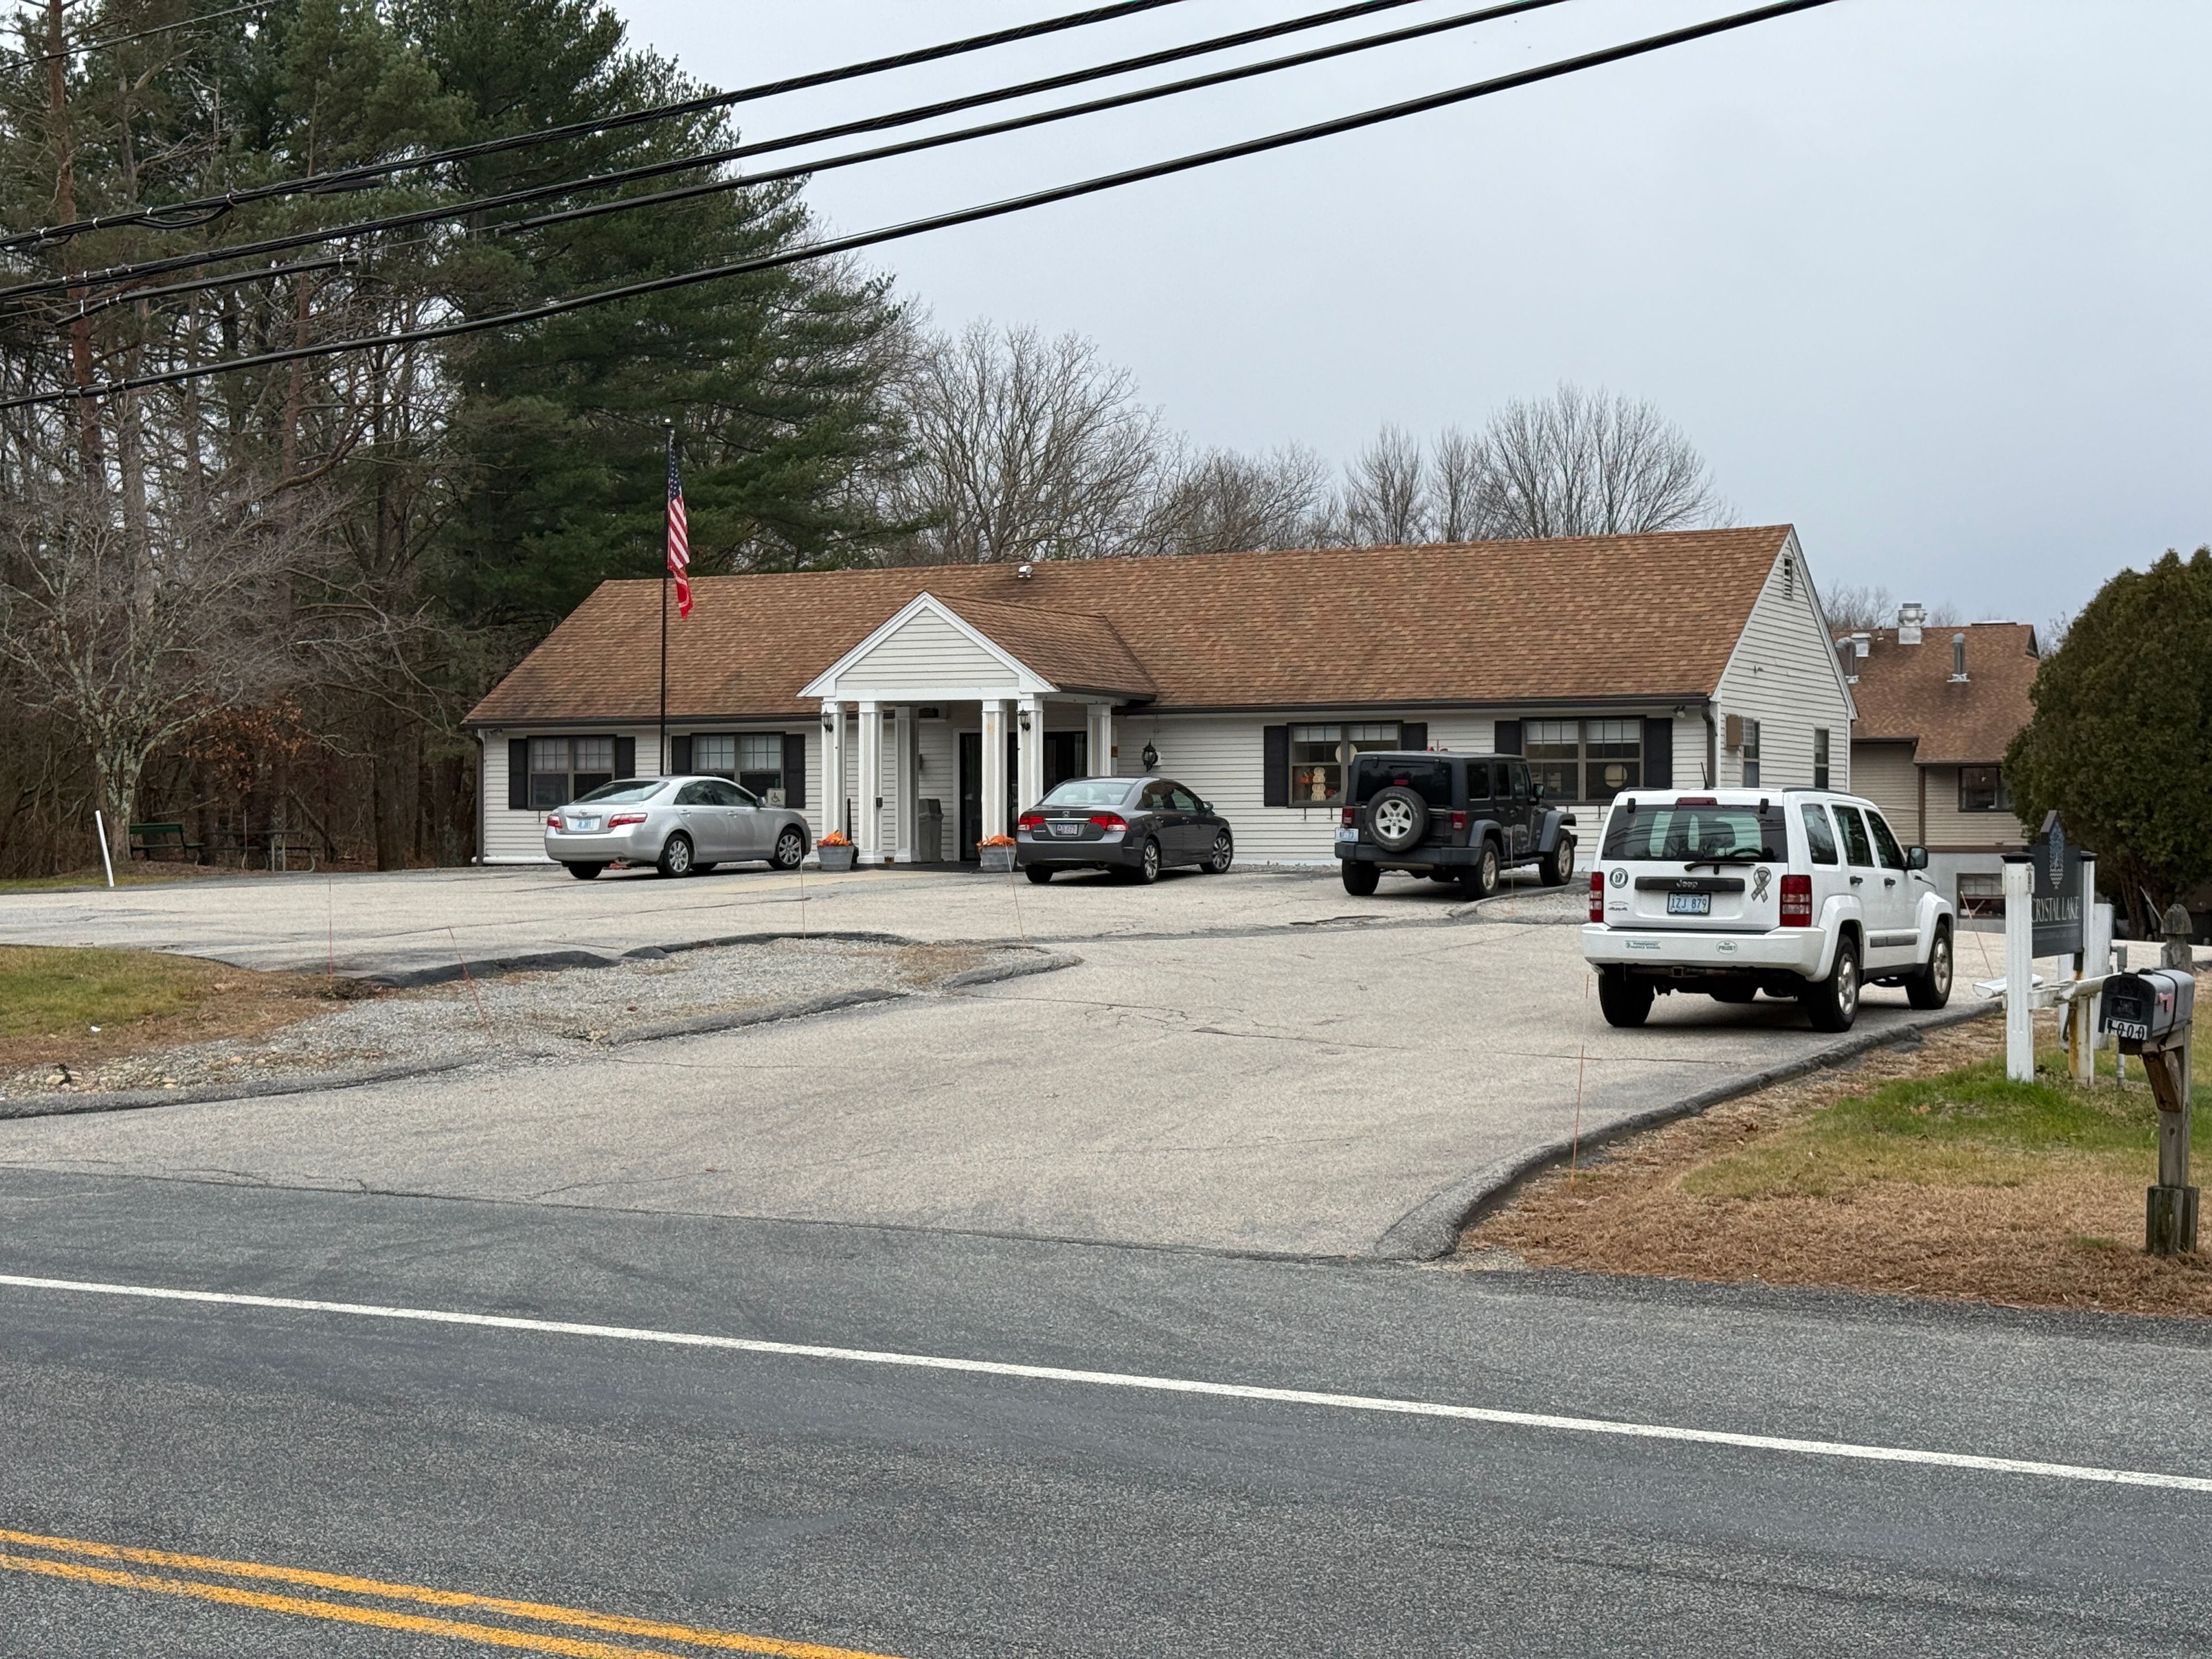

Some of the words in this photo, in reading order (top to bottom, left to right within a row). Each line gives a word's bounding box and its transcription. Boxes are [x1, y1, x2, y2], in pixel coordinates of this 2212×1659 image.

[1676, 879, 1698, 889] Jeep
[1691, 898, 1707, 909] 879
[2032, 897, 2061, 923] CRYSTAL
[2062, 896, 2079, 921] LAKE
